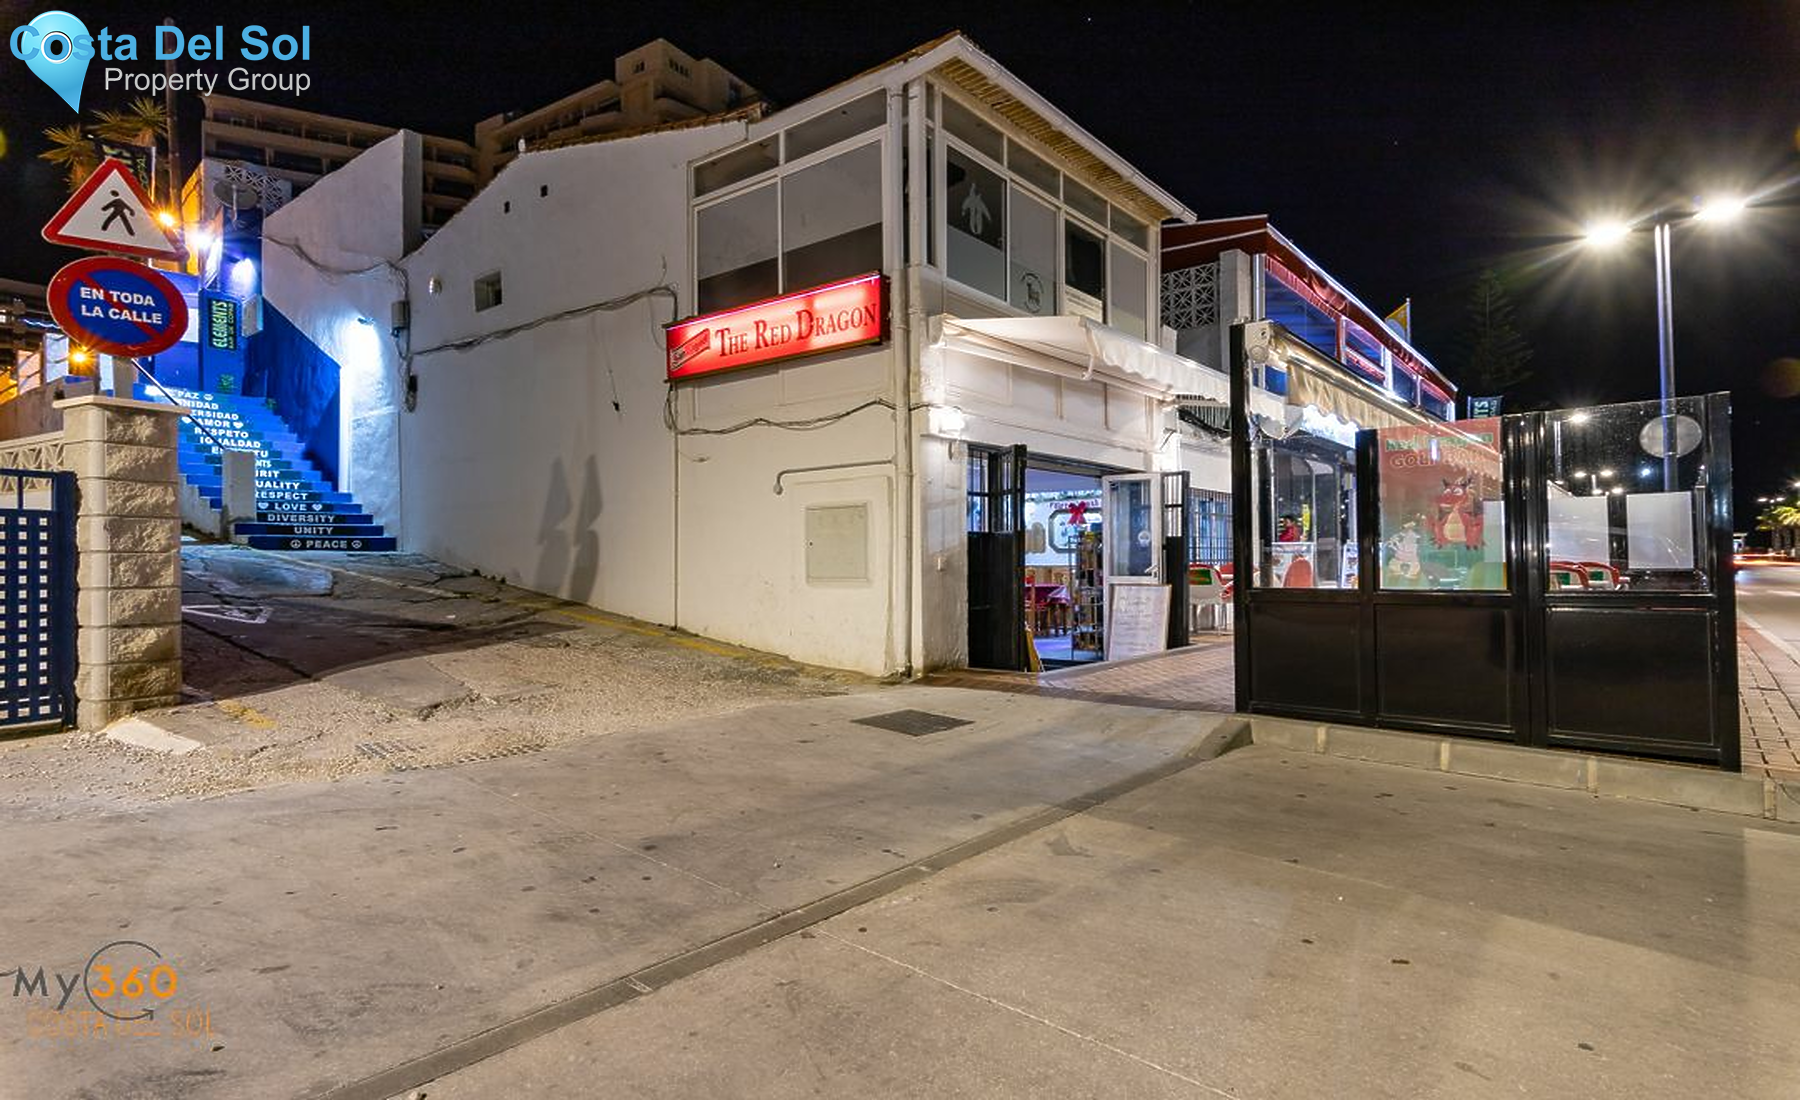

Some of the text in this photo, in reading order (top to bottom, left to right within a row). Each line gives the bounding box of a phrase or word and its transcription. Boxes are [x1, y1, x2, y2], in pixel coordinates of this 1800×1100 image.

[80, 286, 155, 307] EN TODA
[80, 304, 163, 324] LA CALLE
[714, 326, 748, 357] THE
[753, 319, 792, 350] RED
[795, 303, 878, 342] DRAGON
[274, 502, 307, 511] LOVE
[267, 513, 335, 523] DIVERSITY
[293, 526, 334, 536] UNITY
[306, 540, 348, 549] PEACE
